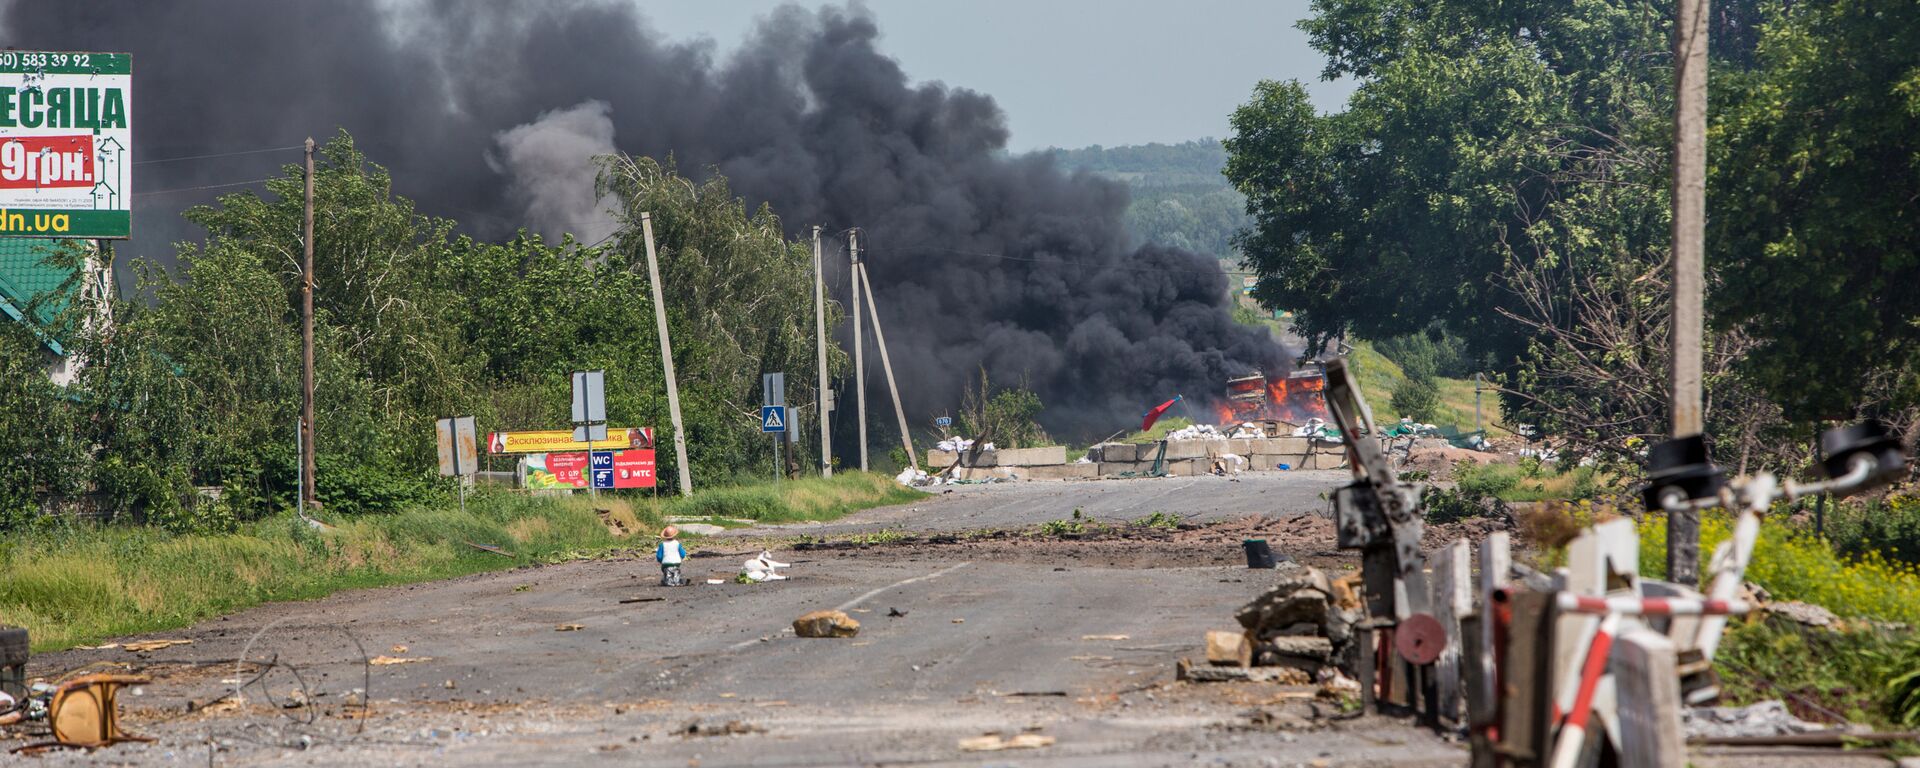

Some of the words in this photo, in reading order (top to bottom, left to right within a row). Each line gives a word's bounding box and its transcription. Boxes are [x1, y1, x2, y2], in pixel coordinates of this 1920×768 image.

[21, 53, 47, 66] 583
[51, 54, 68, 67] 39
[72, 54, 90, 67] 92
[1, 140, 92, 185] 9грн.
[507, 436, 574, 446] Эксклюзивная
[593, 456, 610, 465] WC
